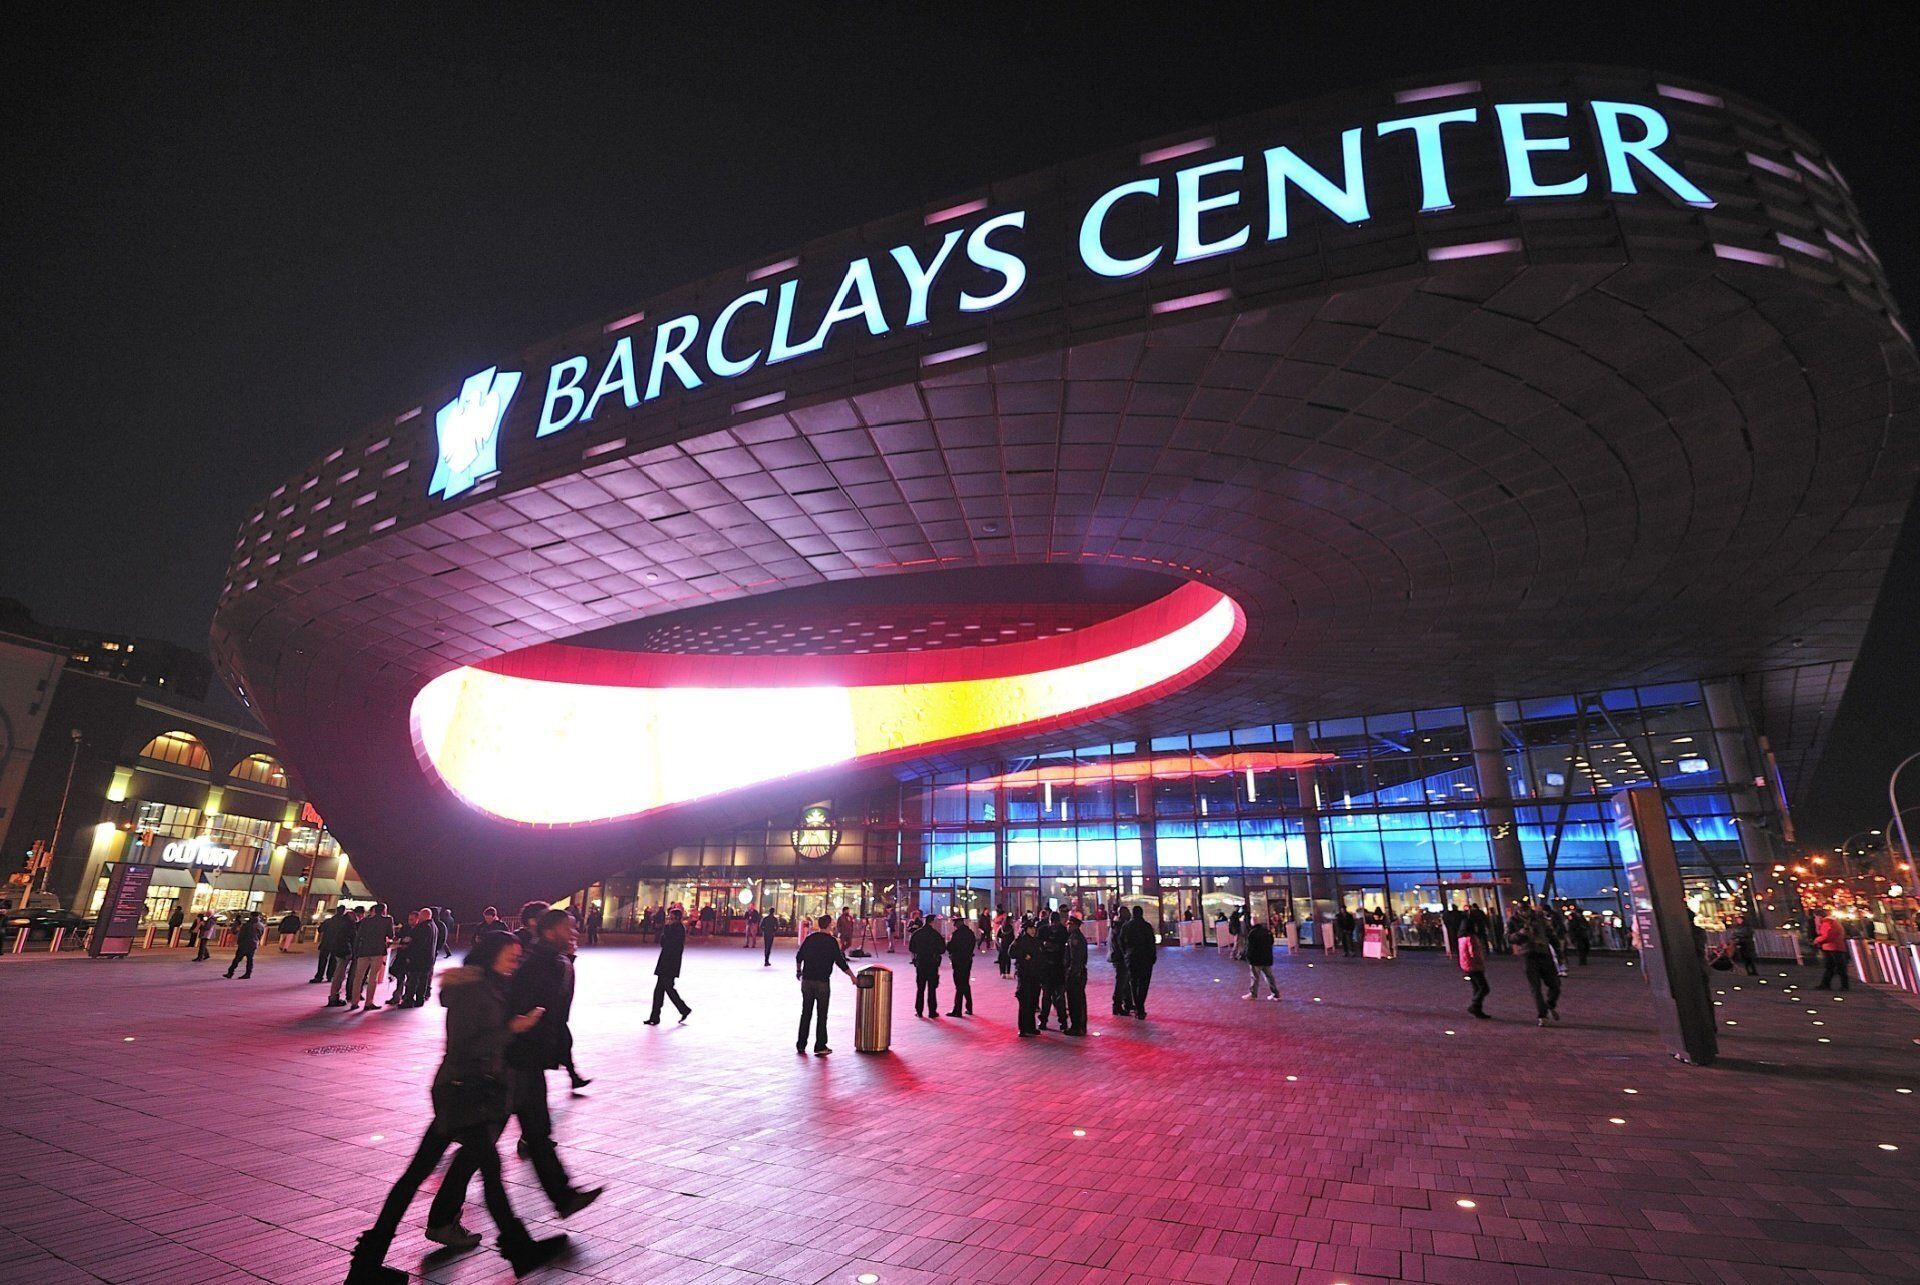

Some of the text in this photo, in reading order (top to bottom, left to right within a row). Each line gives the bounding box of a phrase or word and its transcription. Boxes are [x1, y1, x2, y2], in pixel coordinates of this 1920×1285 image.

[537, 101, 1717, 438] BARCLAYS CENTER
[162, 842, 238, 867] OLD NAVY
